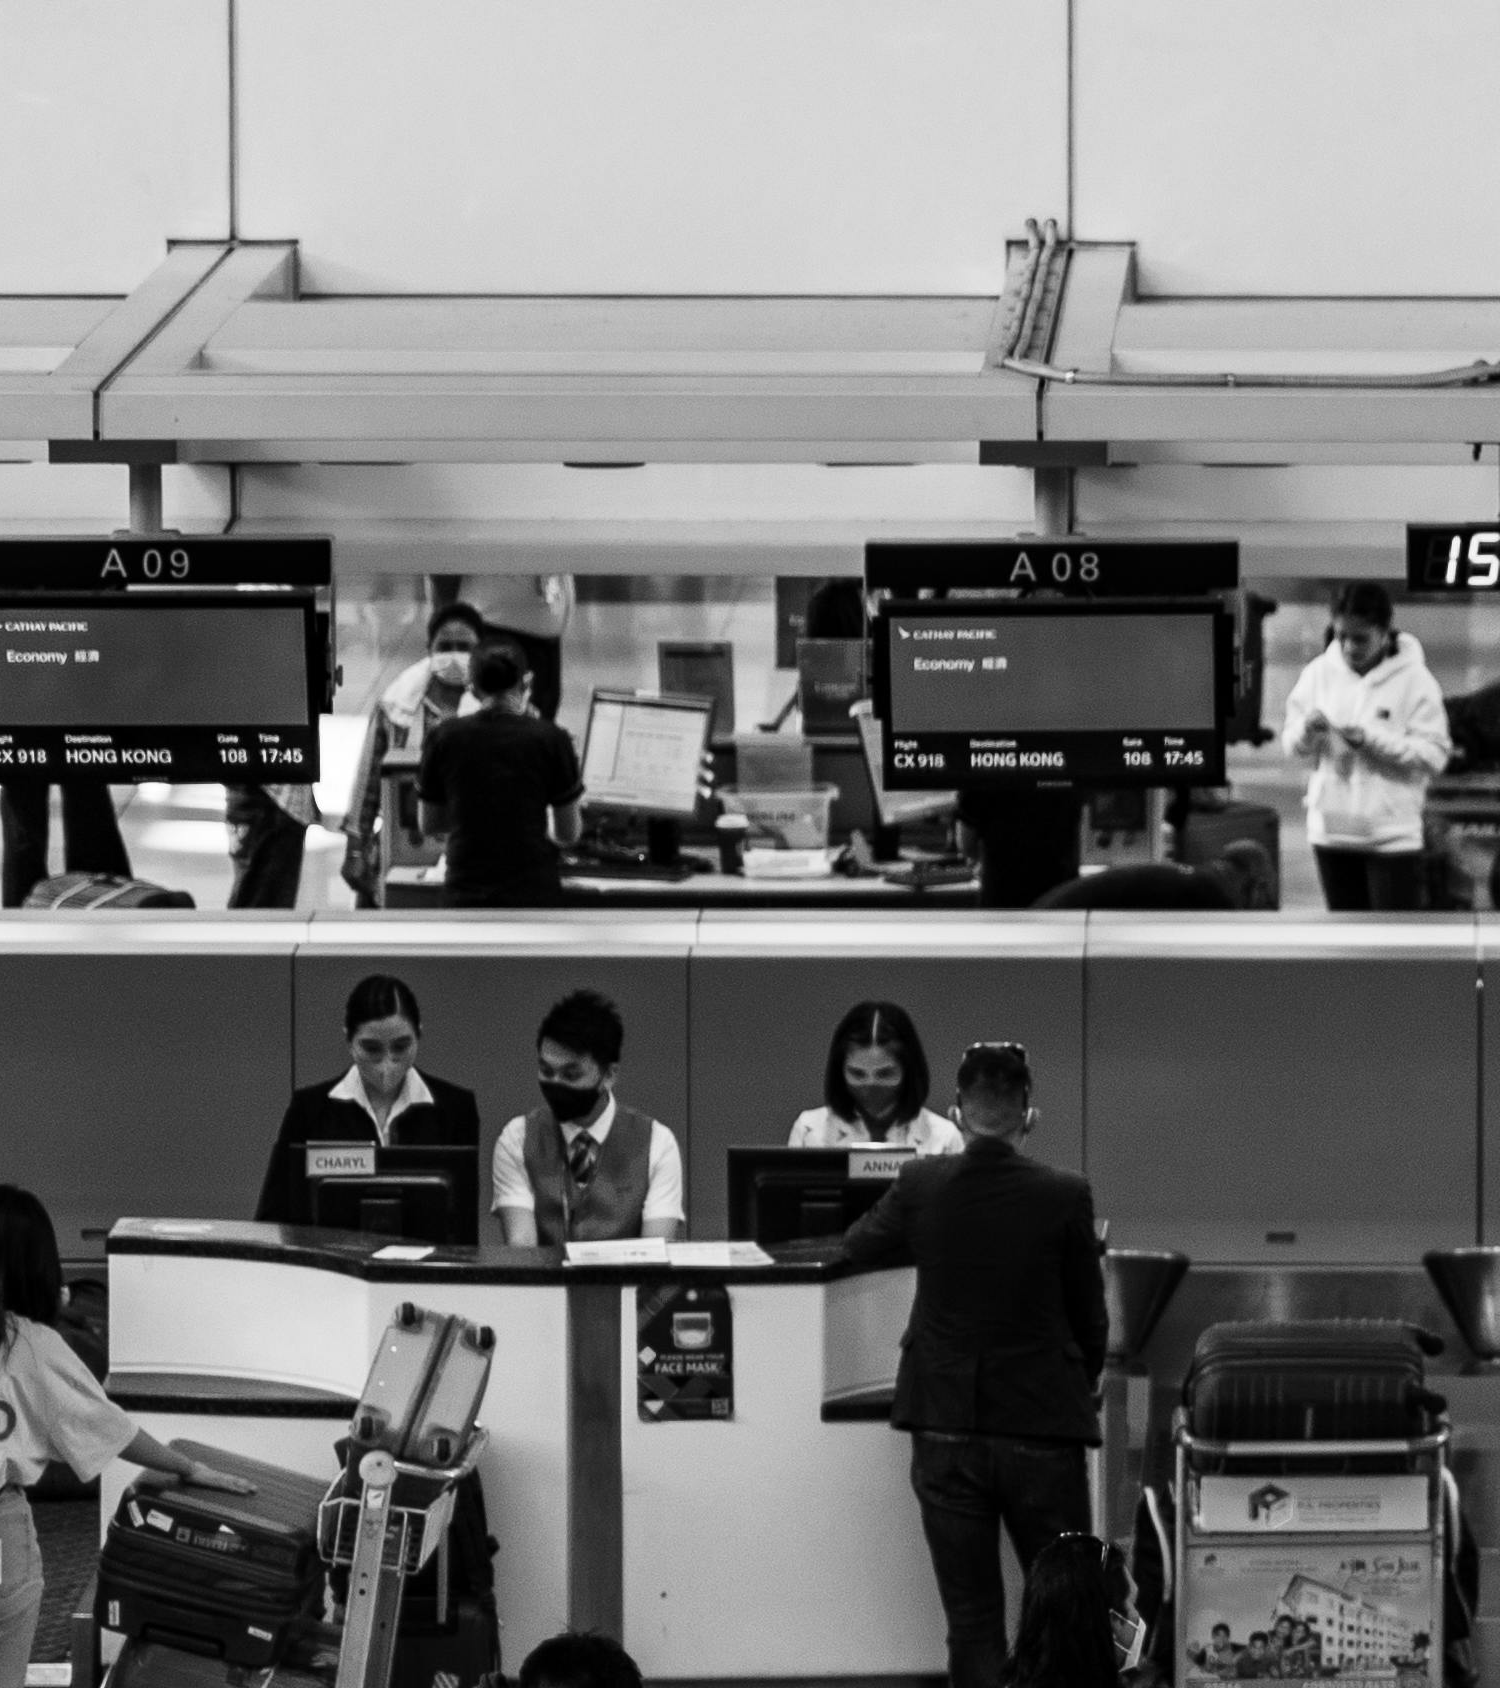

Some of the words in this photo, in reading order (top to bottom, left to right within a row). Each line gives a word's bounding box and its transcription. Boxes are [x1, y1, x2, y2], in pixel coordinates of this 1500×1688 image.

[100, 547, 128, 578] A
[142, 548, 190, 578] 09
[1009, 551, 1037, 582] A
[1051, 552, 1100, 582] 08
[6, 649, 67, 665] Economy
[913, 656, 975, 672] Economy
[16, 748, 47, 764] 918
[65, 748, 117, 764] HONG
[120, 748, 171, 764] KONG
[219, 748, 247, 764] 108
[259, 747, 303, 764] 17:45
[893, 752, 915, 769] CX
[917, 752, 945, 769] 918
[970, 750, 1017, 768] HONG
[1019, 750, 1064, 768] KONG
[1122, 750, 1151, 767] 108
[1163, 749, 1204, 767] 17:45
[315, 1156, 366, 1169] CHARYL
[654, 1362, 683, 1375] FACE
[685, 1361, 720, 1375] MASK
